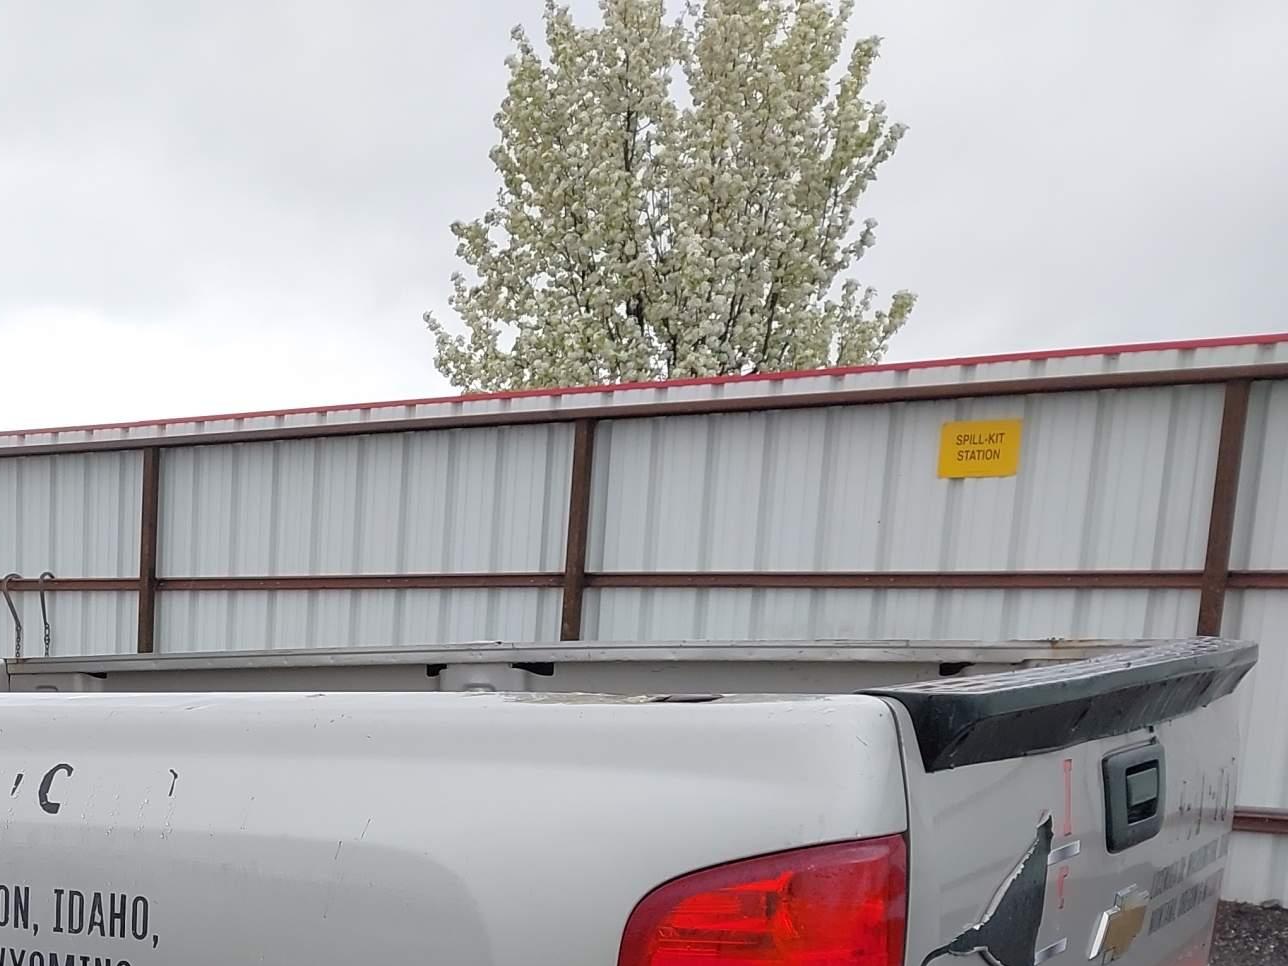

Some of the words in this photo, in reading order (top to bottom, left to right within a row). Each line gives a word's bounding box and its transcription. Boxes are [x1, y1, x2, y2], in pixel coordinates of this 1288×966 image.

[956, 433, 1005, 446] SPILL-KIT
[957, 449, 1001, 461] STATION
[52, 888, 159, 949] IDAHO,
